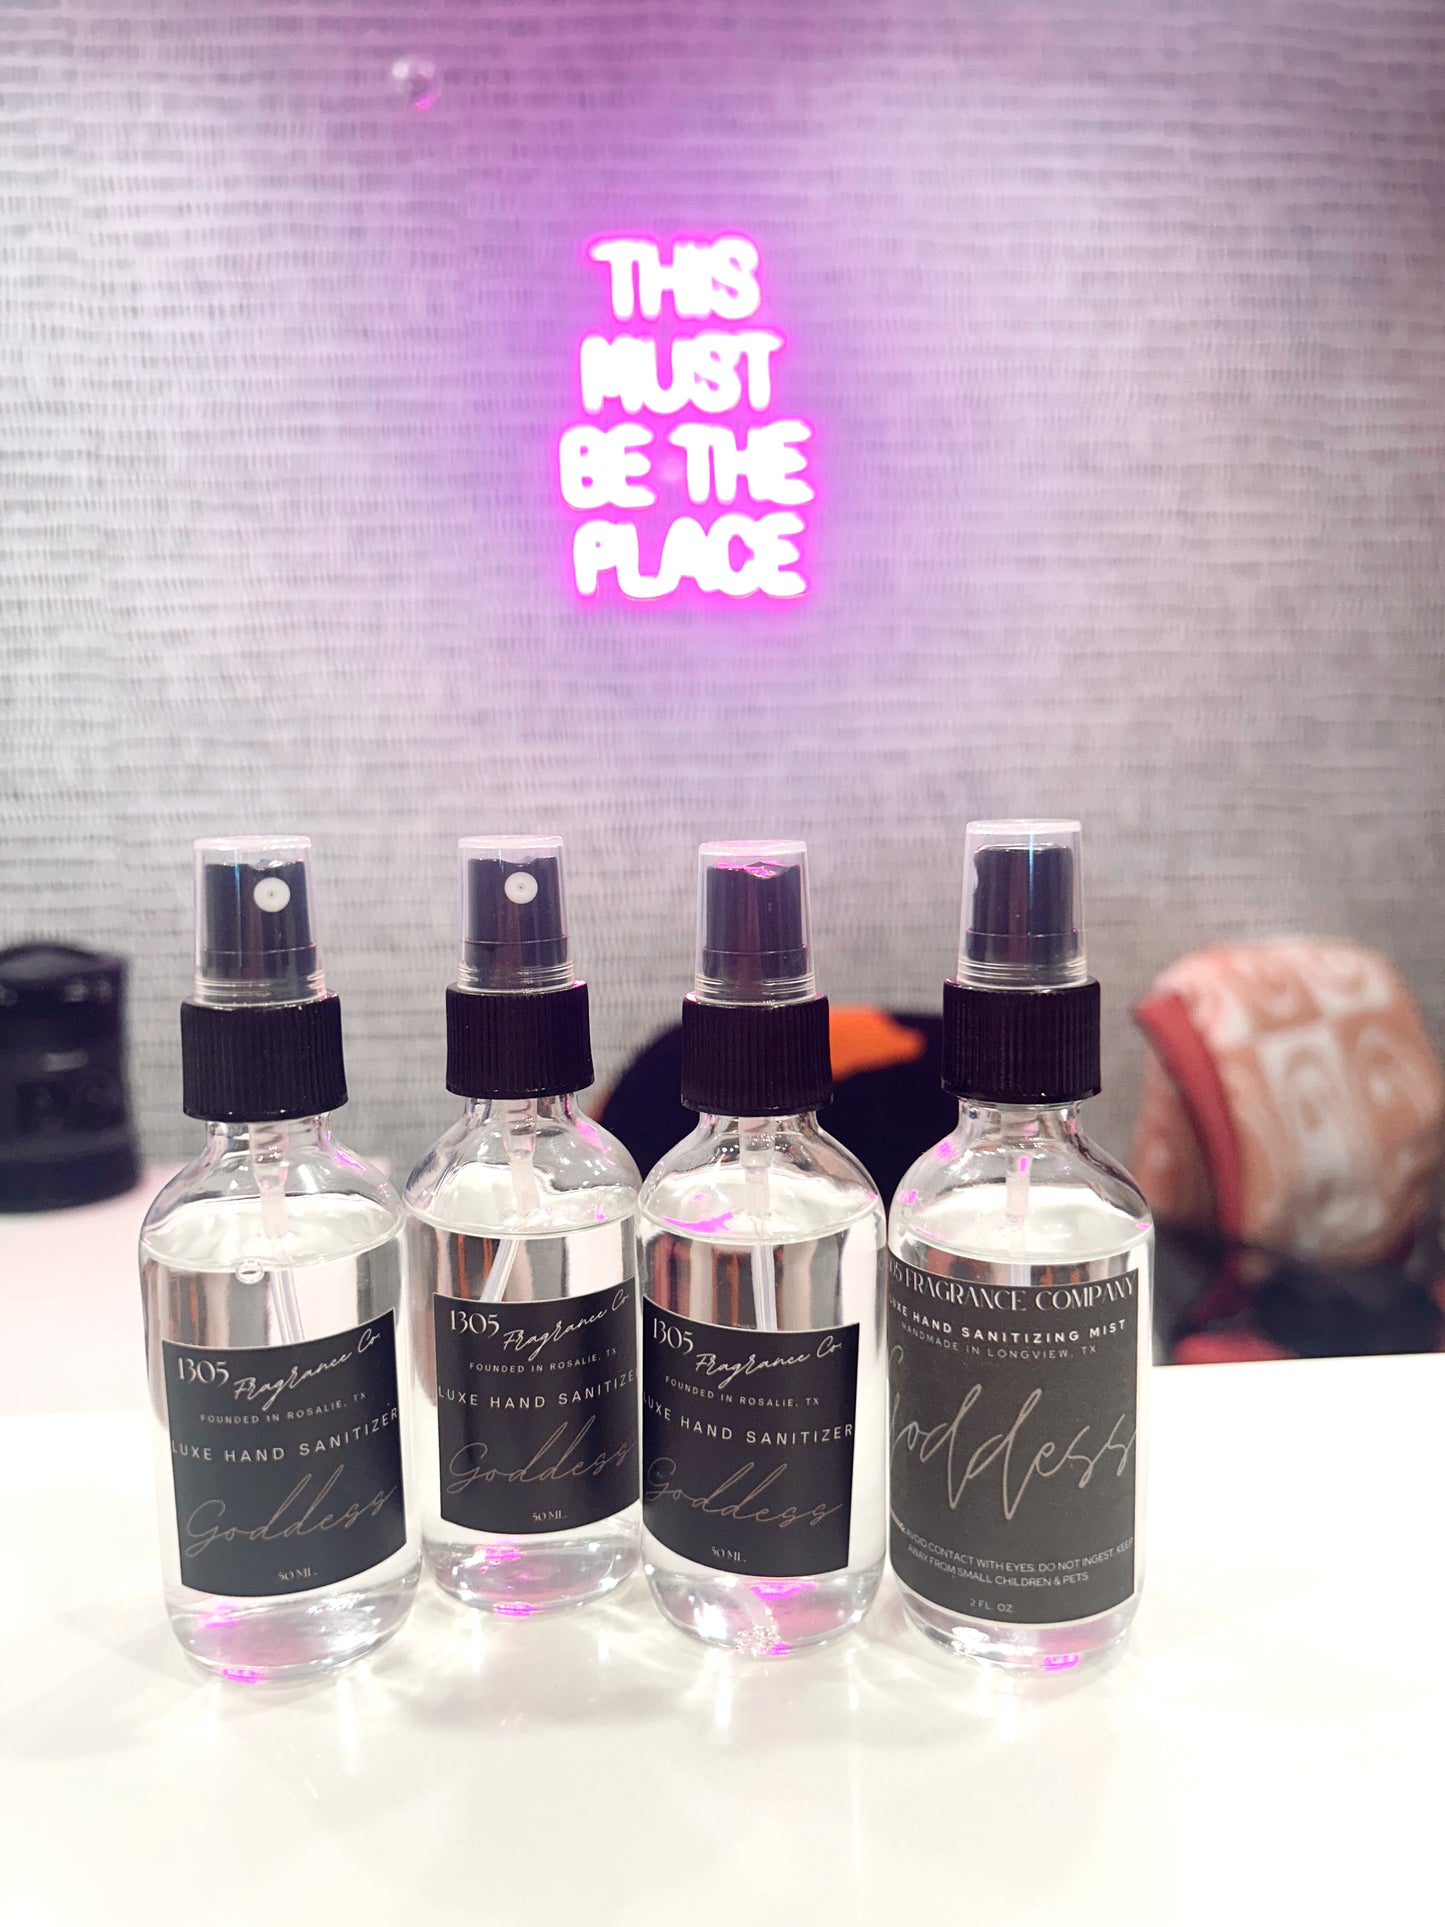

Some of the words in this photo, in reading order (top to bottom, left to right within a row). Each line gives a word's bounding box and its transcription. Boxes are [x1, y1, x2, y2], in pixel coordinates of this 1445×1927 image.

[588, 235, 762, 321] THIS
[579, 330, 784, 414] MUST
[558, 424, 658, 510] BE
[667, 419, 816, 506] THE
[572, 511, 808, 599] PLACE
[905, 1267, 1027, 1311] FRAGRANCE
[1034, 1272, 1138, 1312] COMPANY
[449, 1309, 500, 1338] 1305
[502, 1309, 608, 1362] Fragrance
[652, 1317, 695, 1354] 1305
[695, 1352, 811, 1389] Fragrance
[900, 1322, 960, 1352] HANDMADE
[965, 1345, 980, 1355] IN
[1081, 1345, 1097, 1355] TX
[912, 1311, 953, 1334] HAND
[961, 1326, 1080, 1344] SANITIZING
[1088, 1319, 1126, 1339] MIST
[177, 1357, 230, 1387] 1305
[233, 1351, 353, 1411] Fragrance
[469, 1362, 525, 1373] FOUNDED
[531, 1363, 544, 1373] IN
[605, 1347, 617, 1358] TX
[200, 1413, 260, 1425] FOUNDED
[266, 1413, 280, 1423] IN
[353, 1391, 366, 1402] TX
[437, 1386, 479, 1405] LUXE
[490, 1396, 546, 1409] HAND
[558, 1367, 637, 1405] SANITIZE
[665, 1375, 714, 1399] FOUNDED
[720, 1393, 733, 1403] IN
[805, 1396, 820, 1407] TX
[171, 1439, 213, 1461] LUXE
[224, 1446, 286, 1463] HAND
[299, 1407, 398, 1457] SANITIZER
[643, 1390, 672, 1421] LUXE
[680, 1415, 734, 1440] HAND
[746, 1423, 853, 1446] SANITIZER
[446, 1414, 637, 1494] Goddess
[184, 1464, 397, 1558] Goddess
[645, 1456, 844, 1528] Goddess
[927, 1542, 975, 1566] CONTACT
[976, 1557, 1004, 1571] WITH
[1038, 1563, 1056, 1573] DO
[1057, 1559, 1081, 1571] NOT
[928, 1555, 957, 1575] FROM
[957, 1567, 993, 1584] SMALL
[994, 1575, 1052, 1587] CHILDREN
[1053, 1576, 1062, 1586] &
[1062, 1571, 1089, 1585] PETS
[969, 1597, 977, 1608] 2
